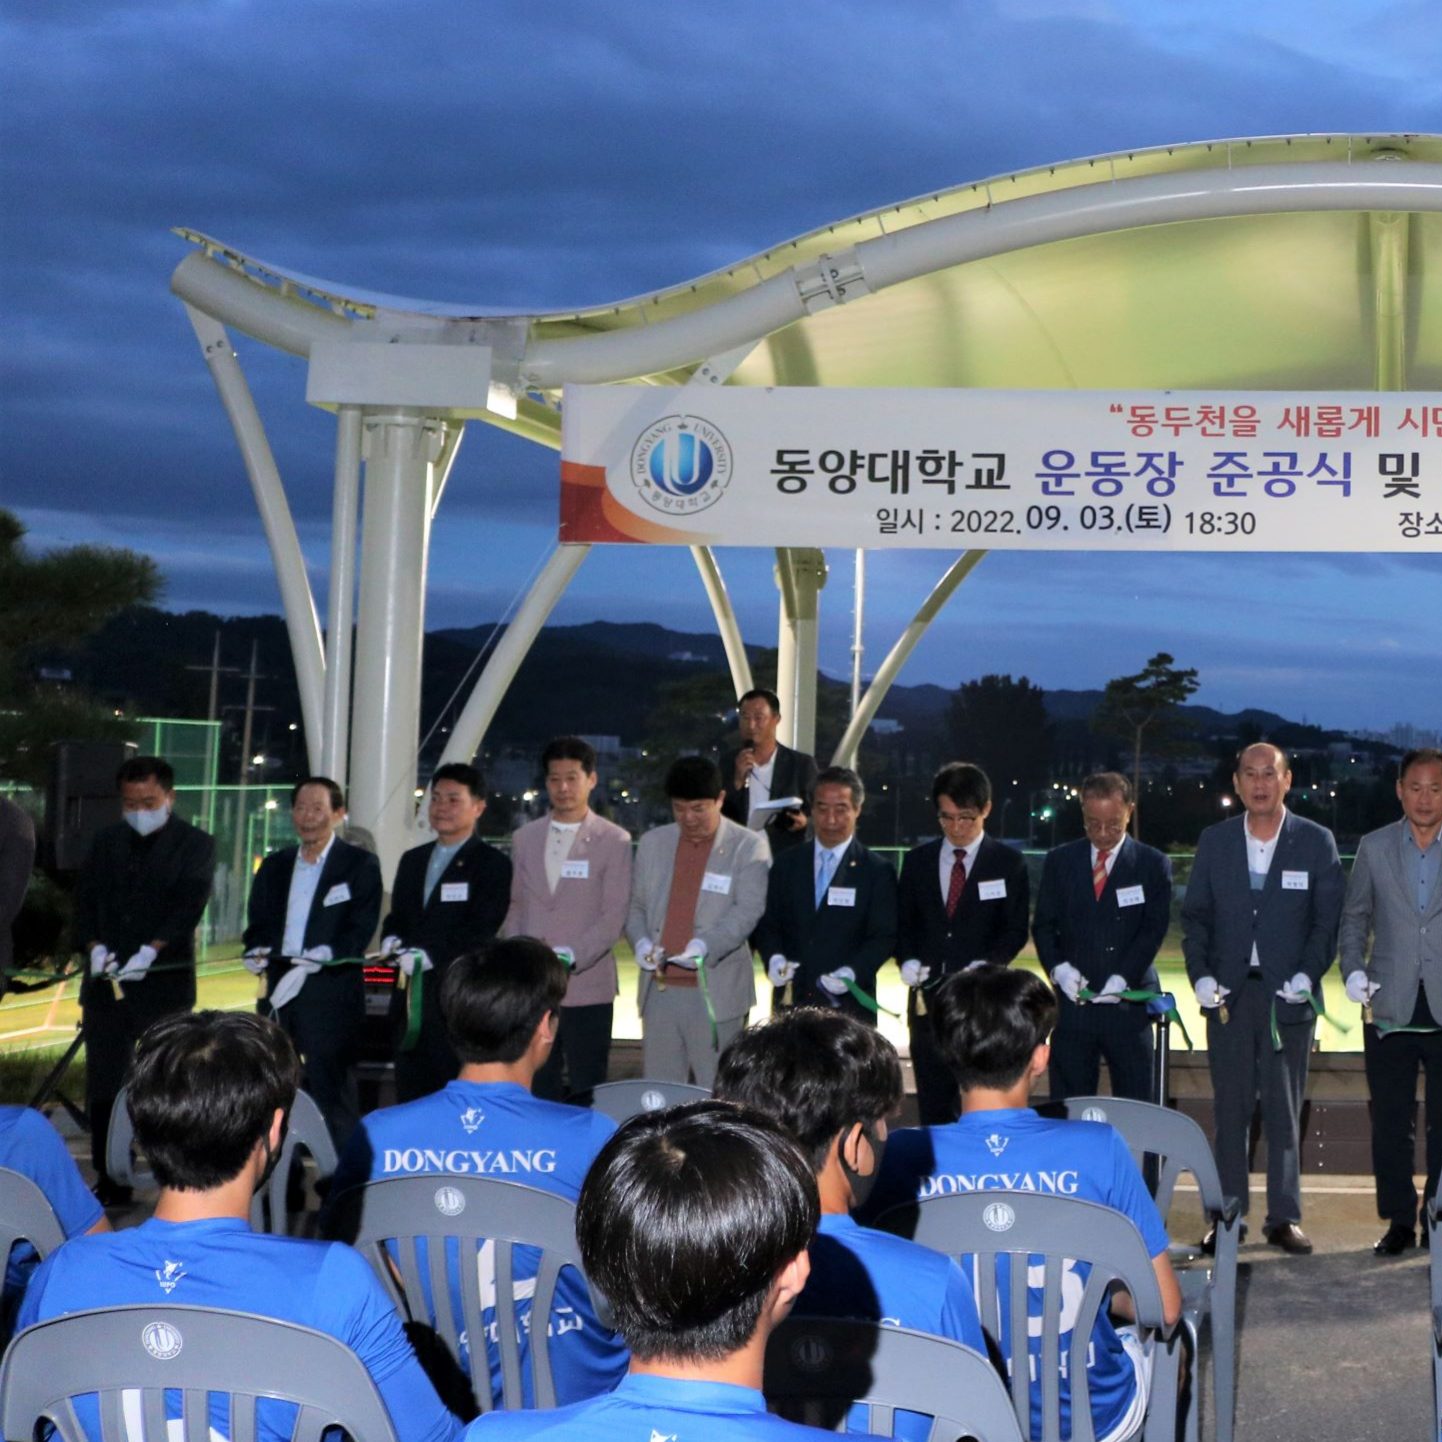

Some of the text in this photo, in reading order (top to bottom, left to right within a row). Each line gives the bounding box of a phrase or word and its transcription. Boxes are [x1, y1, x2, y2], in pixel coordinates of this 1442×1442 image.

[1110, 403, 1262, 438] “동두천을
[1276, 405, 1380, 438] 새롭게
[769, 449, 1011, 495] 동양대학교
[1034, 449, 1184, 498] 운동장
[1206, 451, 1353, 498] 준공식
[1378, 451, 1422, 499] 및
[876, 508, 926, 535] 일시
[1184, 511, 1257, 536] 18:30
[383, 1148, 558, 1174] DONGYANG
[919, 1170, 1080, 1197] DONGYANG
